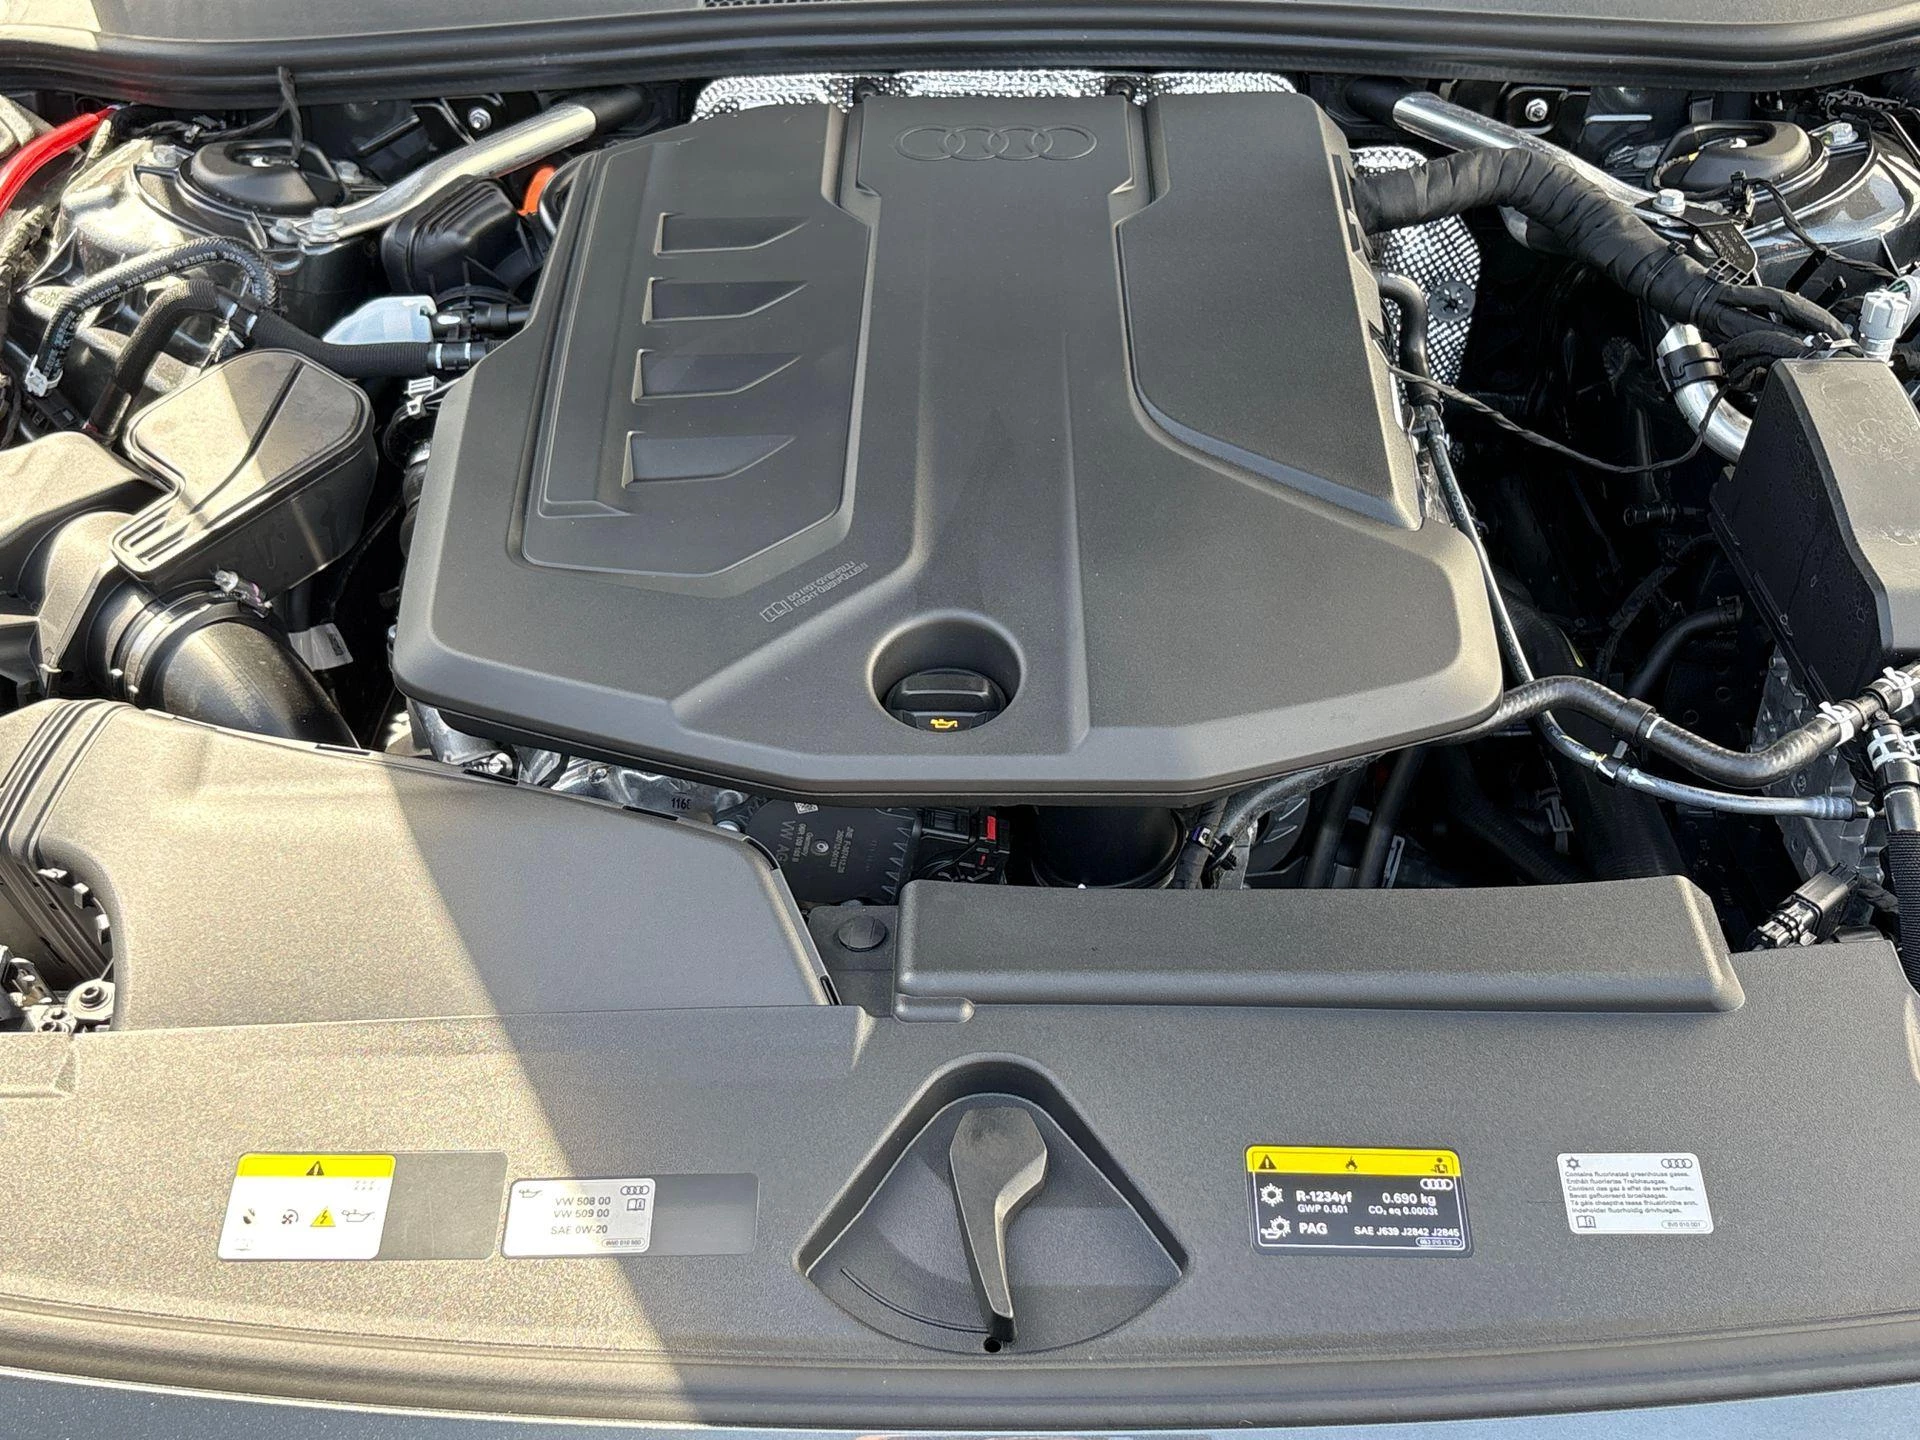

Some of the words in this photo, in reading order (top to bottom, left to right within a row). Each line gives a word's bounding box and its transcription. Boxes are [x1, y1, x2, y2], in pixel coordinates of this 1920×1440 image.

[781, 820, 796, 840] VW
[776, 844, 789, 864] AG
[555, 1198, 574, 1206] VW
[576, 1197, 595, 1205] 508
[598, 1196, 611, 1205] 00
[1296, 1190, 1352, 1204] R-1234yf
[1382, 1192, 1417, 1204] 0.690
[1420, 1193, 1436, 1206] kg
[575, 1209, 594, 1218] 509
[597, 1209, 610, 1217] 00
[1297, 1204, 1321, 1212] GWP
[1389, 1208, 1401, 1216] eq
[550, 1226, 571, 1235] SAE
[575, 1224, 608, 1234] 0W-20
[1299, 1222, 1328, 1234] PAG
[1354, 1226, 1374, 1235] SAE
[1377, 1227, 1399, 1235] J639
[1401, 1228, 1429, 1236] J2842
[1431, 1228, 1460, 1236] J2845
